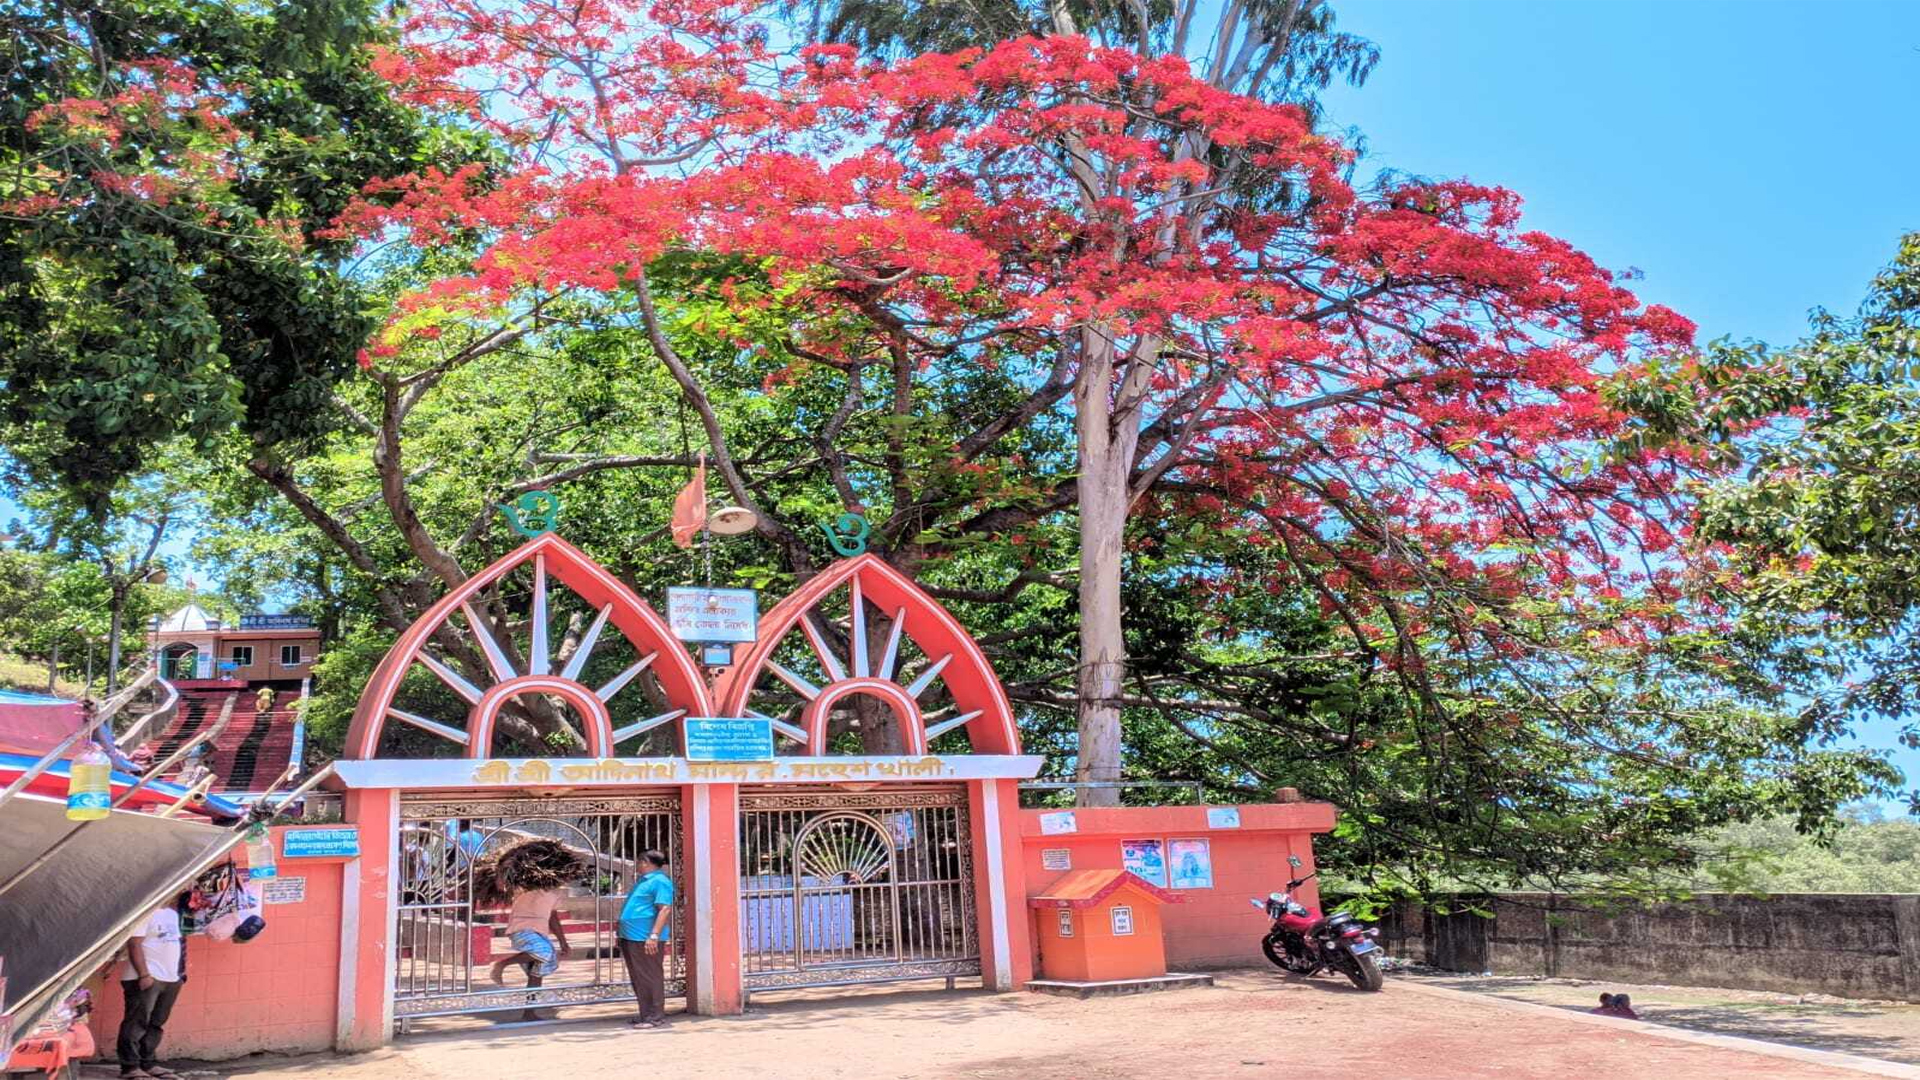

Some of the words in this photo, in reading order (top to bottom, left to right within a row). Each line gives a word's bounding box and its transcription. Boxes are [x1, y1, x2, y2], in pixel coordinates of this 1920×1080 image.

[472, 760, 509, 784] শ্রী
[516, 760, 551, 783] শ্রী
[558, 759, 677, 783] আদিনাথ
